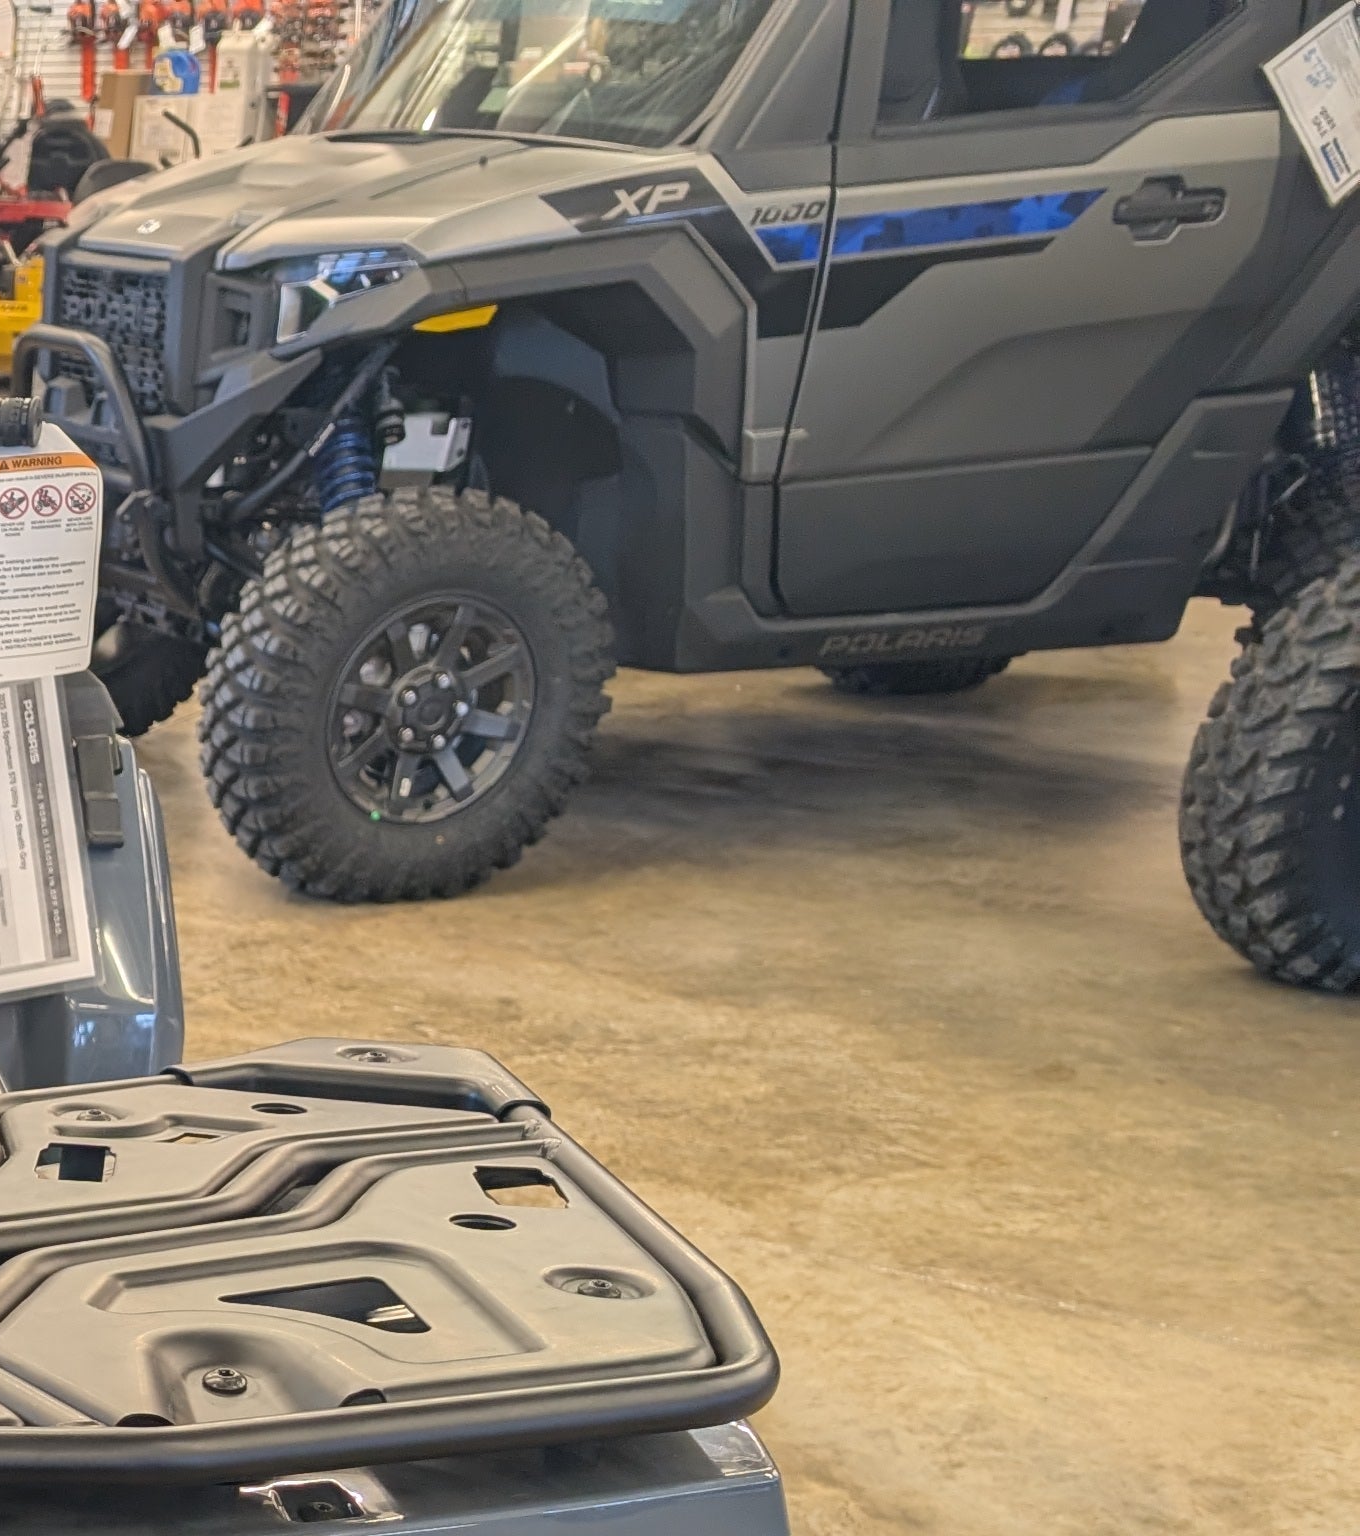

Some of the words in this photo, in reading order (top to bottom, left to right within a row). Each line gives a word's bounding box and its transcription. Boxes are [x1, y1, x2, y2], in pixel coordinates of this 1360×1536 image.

[601, 181, 691, 220] XP
[750, 201, 826, 226] 1000
[11, 455, 63, 469] WARNING
[820, 626, 987, 657] POLARIS
[1, 730, 15, 770] Sportsman
[22, 697, 41, 765] POLARIS
